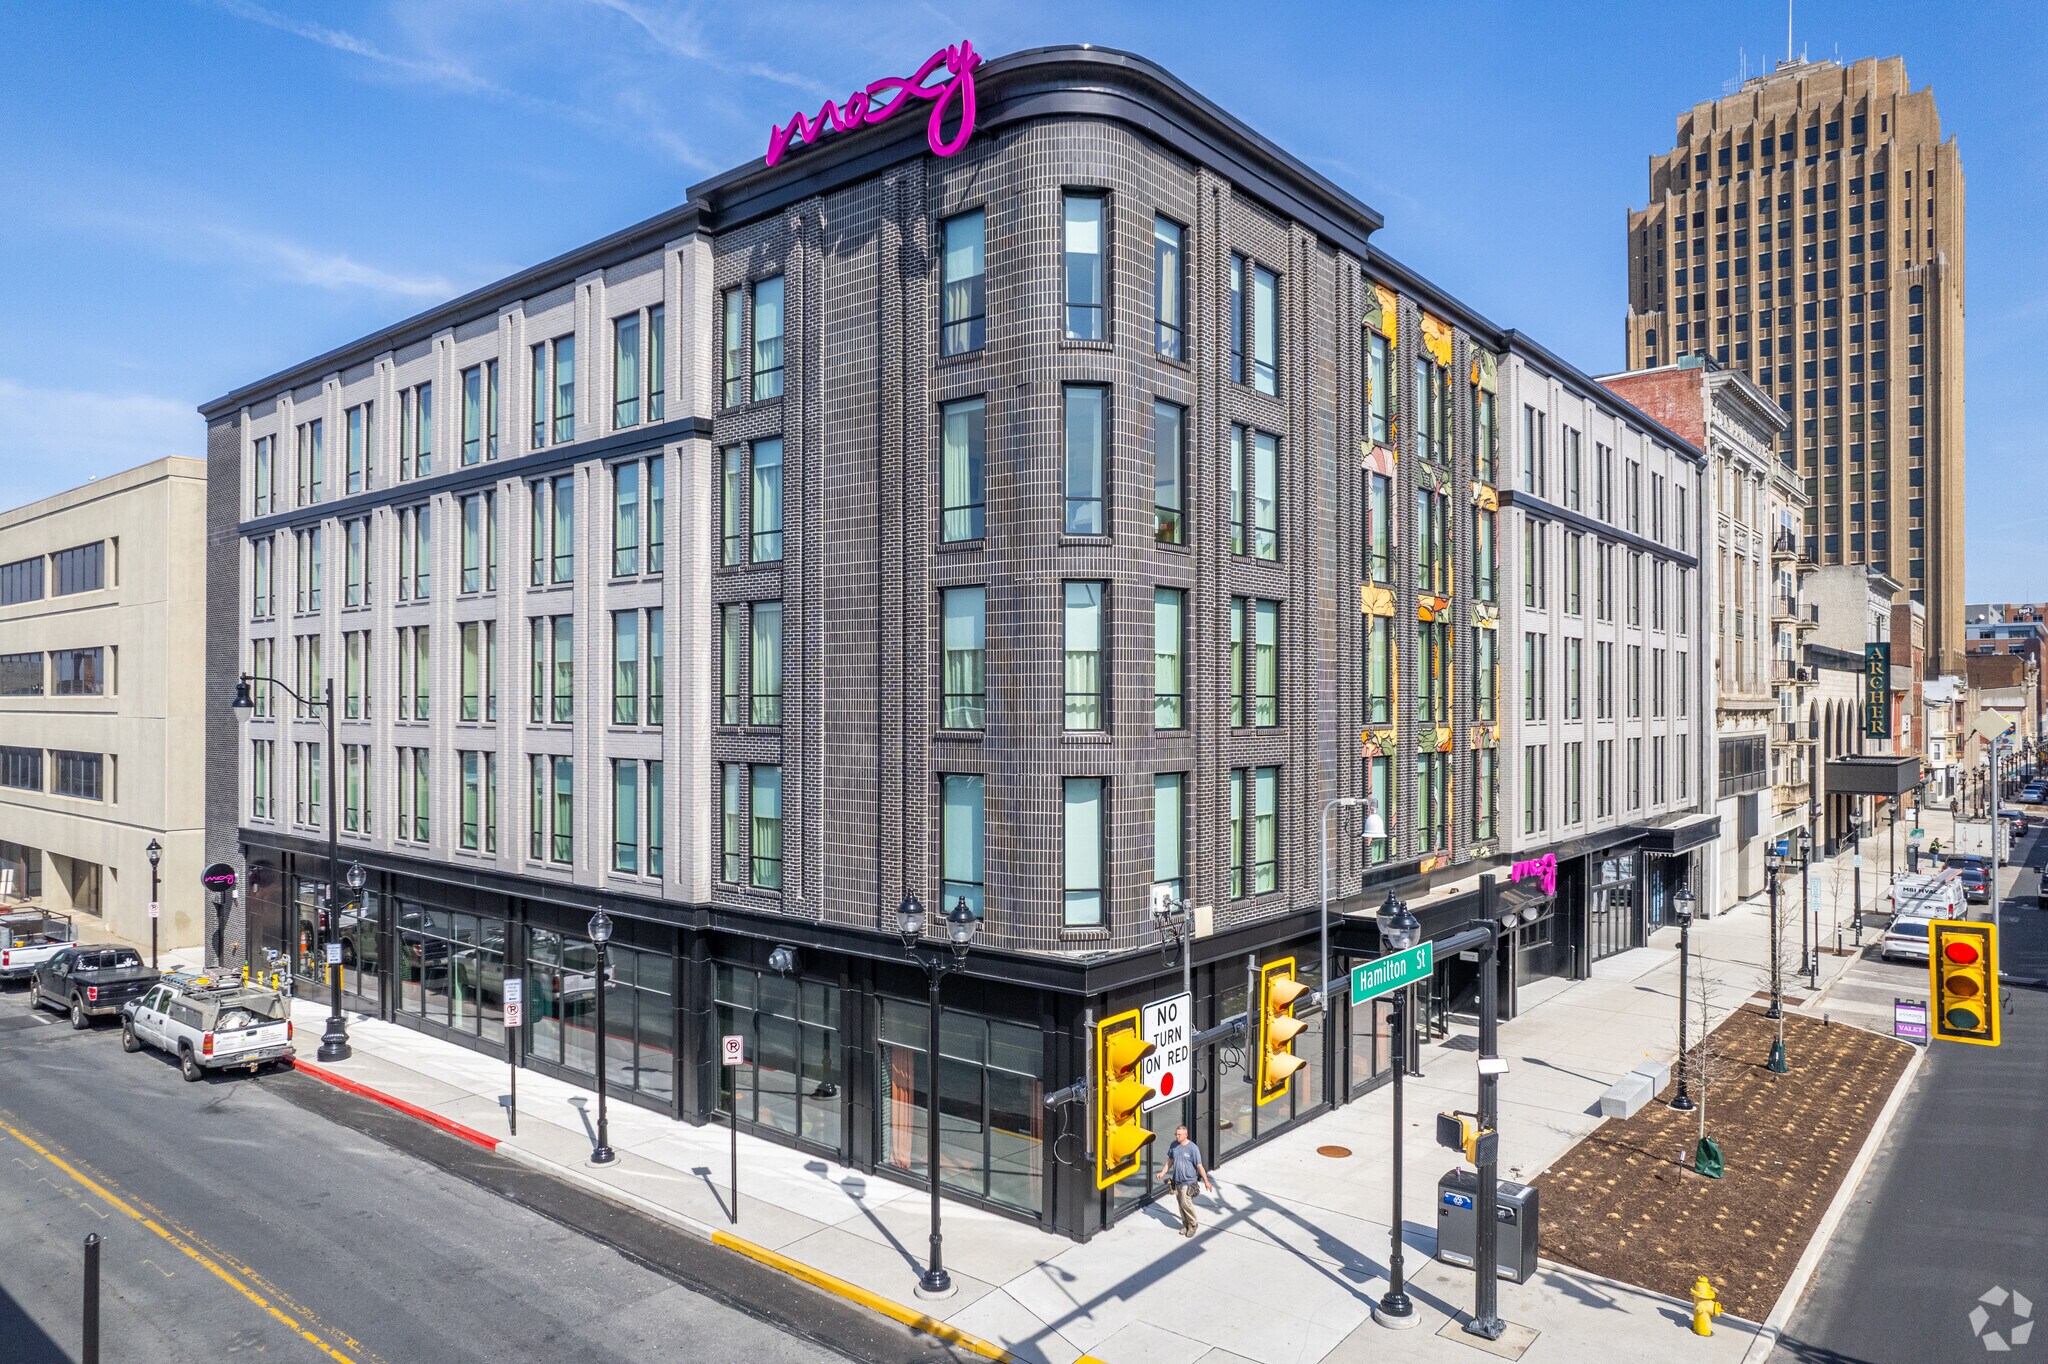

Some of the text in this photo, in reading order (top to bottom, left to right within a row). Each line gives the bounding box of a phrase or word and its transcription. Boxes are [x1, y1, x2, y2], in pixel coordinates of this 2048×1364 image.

[765, 39, 982, 167] moxy
[1869, 647, 1886, 733] ARCHER
[1360, 948, 1426, 991] Hamilton St
[1157, 1003, 1178, 1026] NO
[1898, 1025, 1924, 1033] VALET
[1153, 1025, 1182, 1049] TURN
[1145, 1045, 1189, 1074] ON RED
